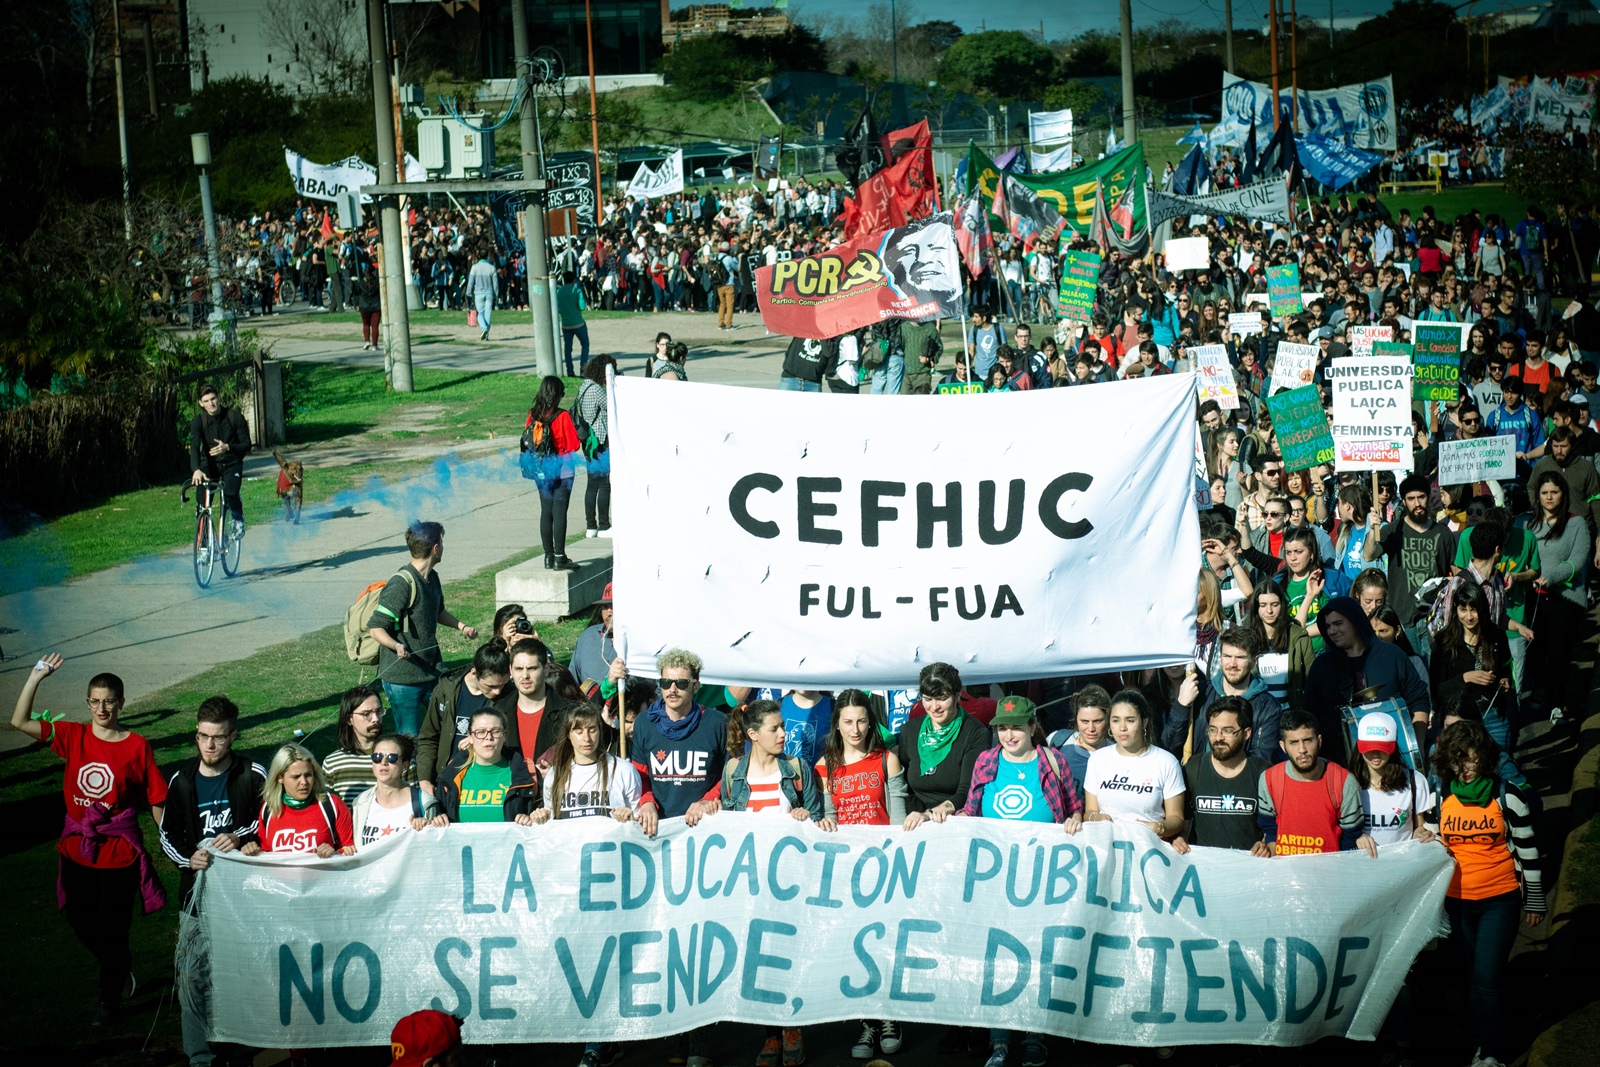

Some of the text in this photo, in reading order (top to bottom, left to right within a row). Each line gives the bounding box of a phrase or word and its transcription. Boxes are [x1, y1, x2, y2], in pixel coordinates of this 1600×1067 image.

[291, 173, 349, 197] RABAJO
[1239, 184, 1275, 208] CINE
[772, 255, 843, 296] PCR
[771, 282, 888, 306] Partido Comunista Revolucionario
[879, 303, 936, 318] SALAMANCA
[1352, 325, 1392, 338] LAS LUCHAS
[1354, 337, 1380, 346] JUSTA
[1279, 343, 1318, 356] UNIVERSIDAD
[1415, 364, 1459, 380] gratuito
[1339, 380, 1404, 392] PUBLICA
[1430, 387, 1459, 400] ALDE
[1270, 398, 1287, 412] NO
[1289, 388, 1318, 405] VAMOS
[1351, 398, 1397, 408] LAICA
[1275, 413, 1285, 423] A
[1368, 409, 1378, 419] Y
[1275, 413, 1320, 435] QUE NOS
[1333, 425, 1414, 437] FEMINISTA
[1281, 422, 1329, 448] ARREBATEN
[1286, 436, 1334, 459] NUESTROS
[1455, 438, 1488, 450] EDUCACIÓN
[1351, 450, 1399, 461] izquierda
[1443, 453, 1459, 462] ARMA
[1479, 449, 1506, 457] PODEROSA
[1440, 465, 1452, 473] QUE
[1476, 462, 1483, 470] EL
[1485, 460, 1503, 468] MUNDO
[728, 471, 1094, 549] CEFHUC
[800, 583, 881, 619] FUL
[929, 584, 1025, 621] FUA
[650, 750, 709, 775] MUE
[832, 771, 880, 793] FETS
[1112, 774, 1129, 783] La
[1100, 780, 1153, 794] Naranja
[459, 789, 503, 804] ALDE
[839, 794, 870, 805] Frente
[848, 810, 878, 820] Trabajo
[1364, 814, 1400, 827] ELLA
[1443, 814, 1497, 831] Allende
[276, 832, 317, 850] MST
[461, 833, 1207, 918] LA EDUCACIÓN PÚBLICA
[278, 918, 1371, 1026] NO SE VENDE, SE DEFIENDE
